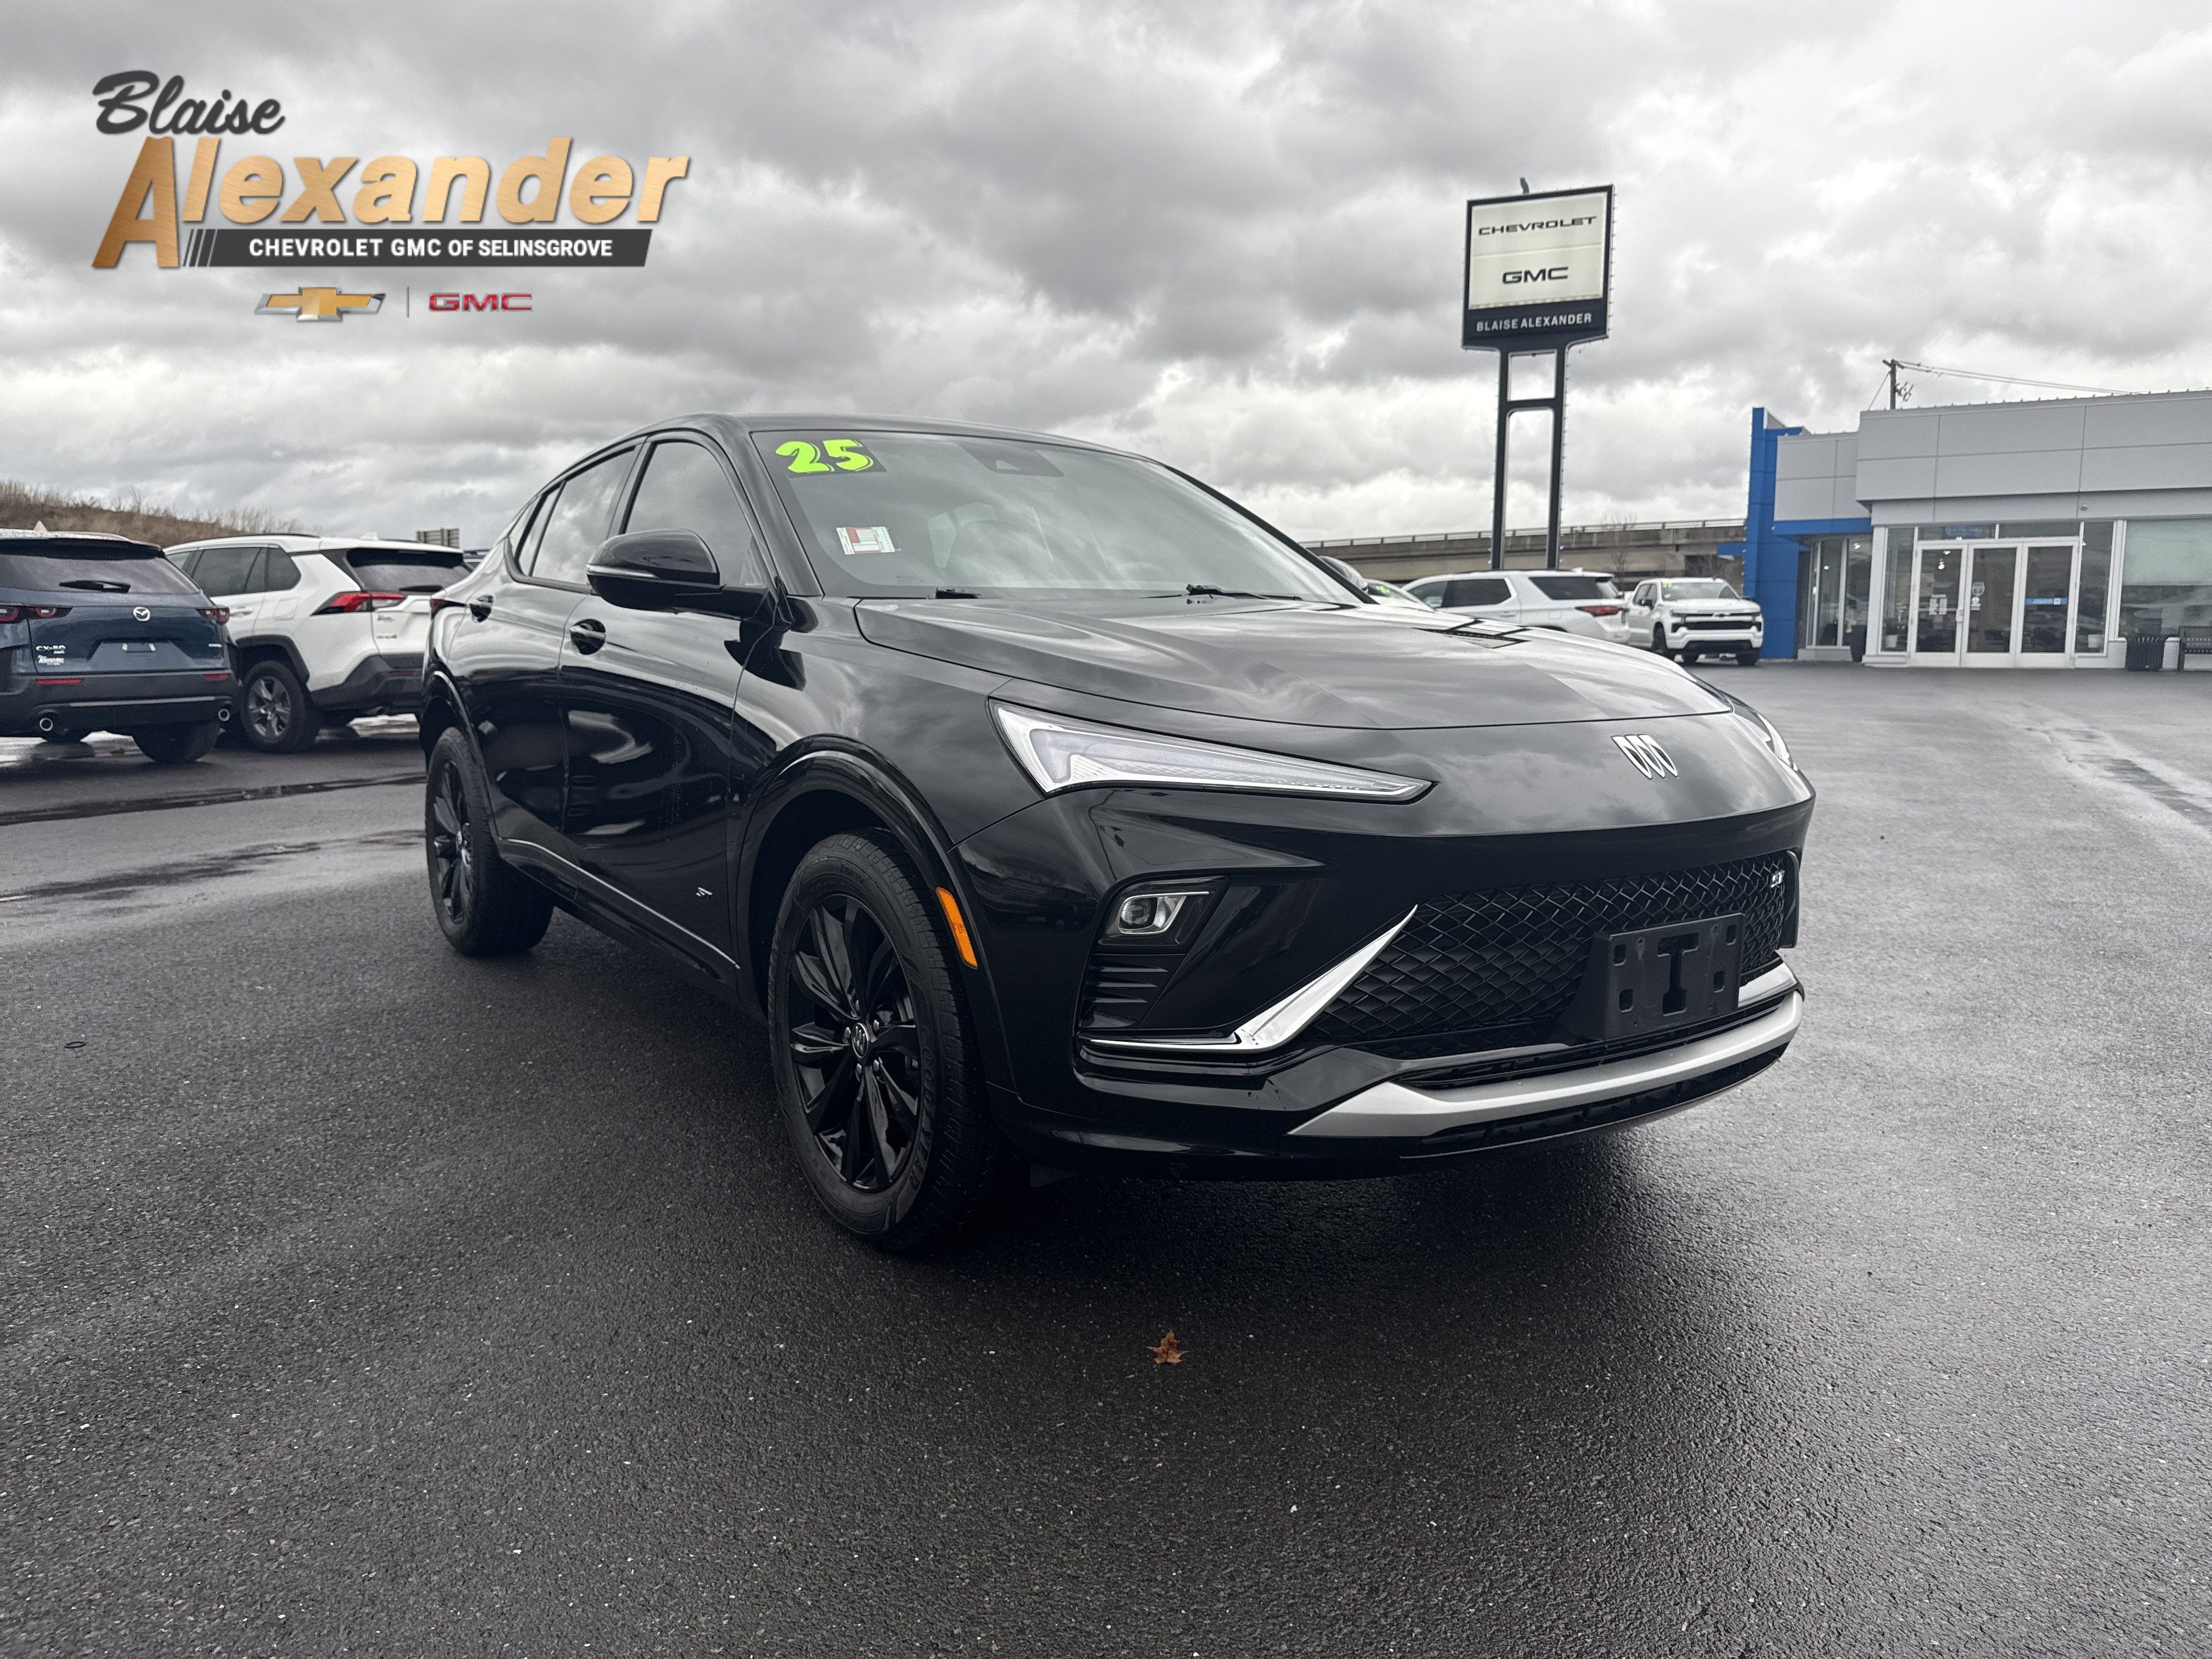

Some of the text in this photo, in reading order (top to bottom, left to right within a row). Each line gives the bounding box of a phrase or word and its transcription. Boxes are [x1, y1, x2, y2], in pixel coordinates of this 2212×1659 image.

[1478, 216, 1596, 235] CHEVROLET
[1502, 266, 1568, 285] GMC
[1476, 312, 1593, 332] BLAISE ALEXANDER
[775, 439, 874, 473] 25
